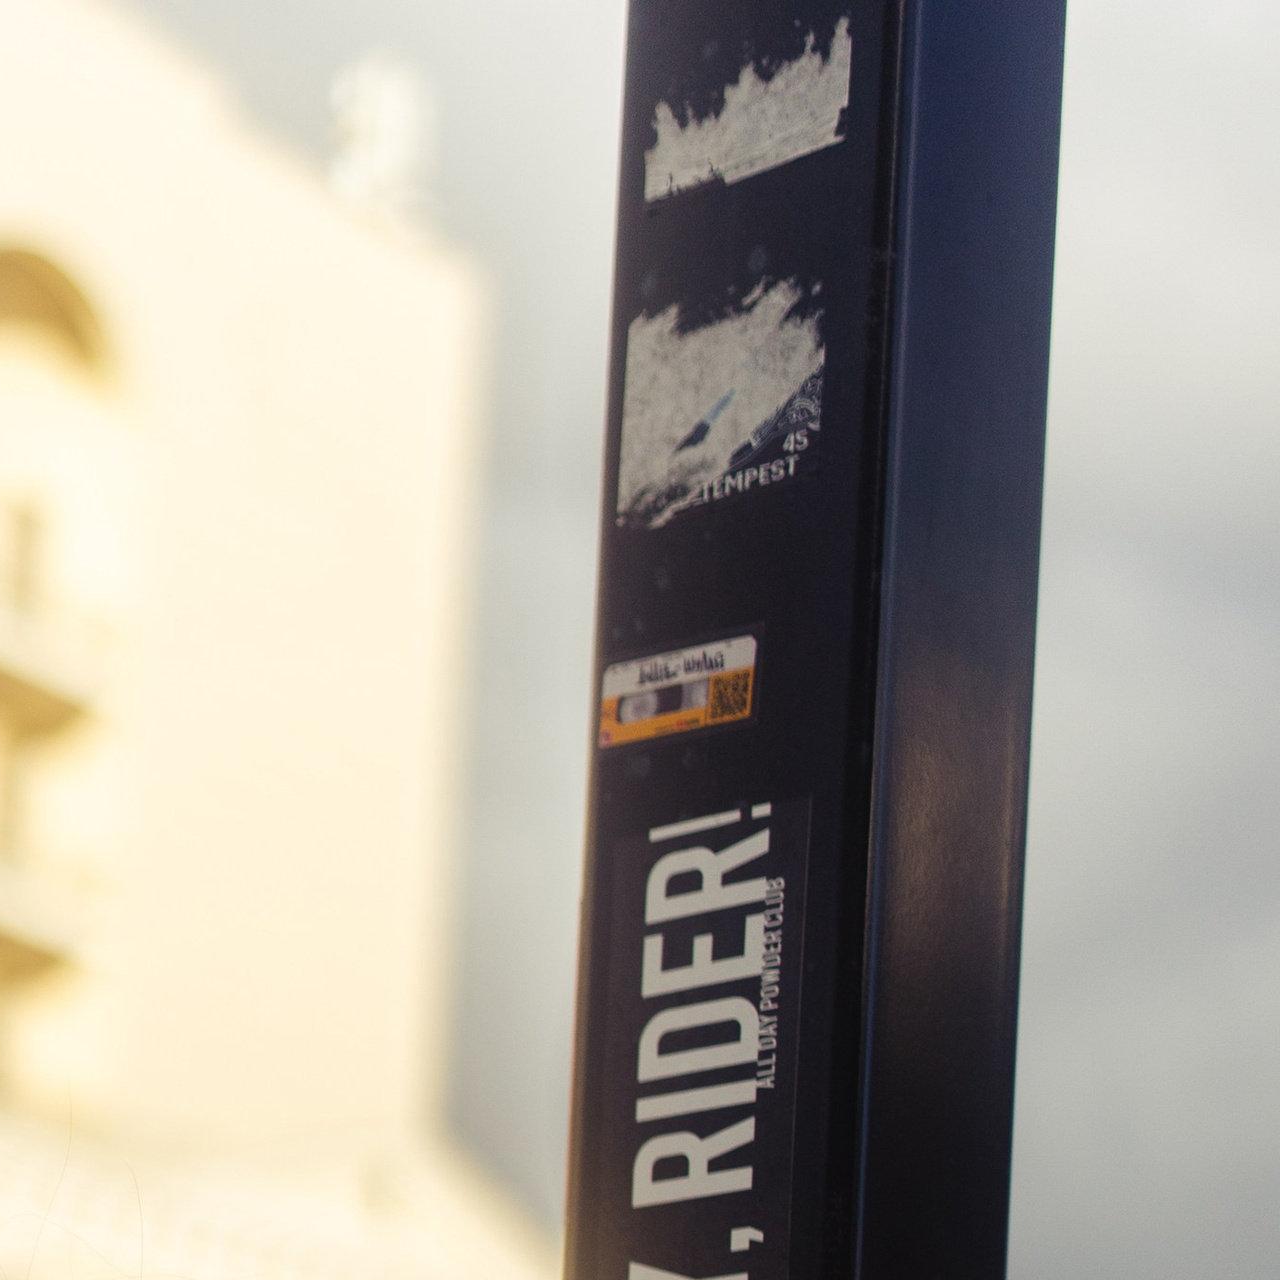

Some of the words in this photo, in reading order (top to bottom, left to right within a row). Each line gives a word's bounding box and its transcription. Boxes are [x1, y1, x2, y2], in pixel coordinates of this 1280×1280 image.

[763, 876, 785, 927] CLUB
[760, 929, 782, 1011] POWDER
[632, 802, 772, 1208] RIDER!
[758, 1014, 778, 1051] DAY
[756, 1052, 776, 1089] ALL
